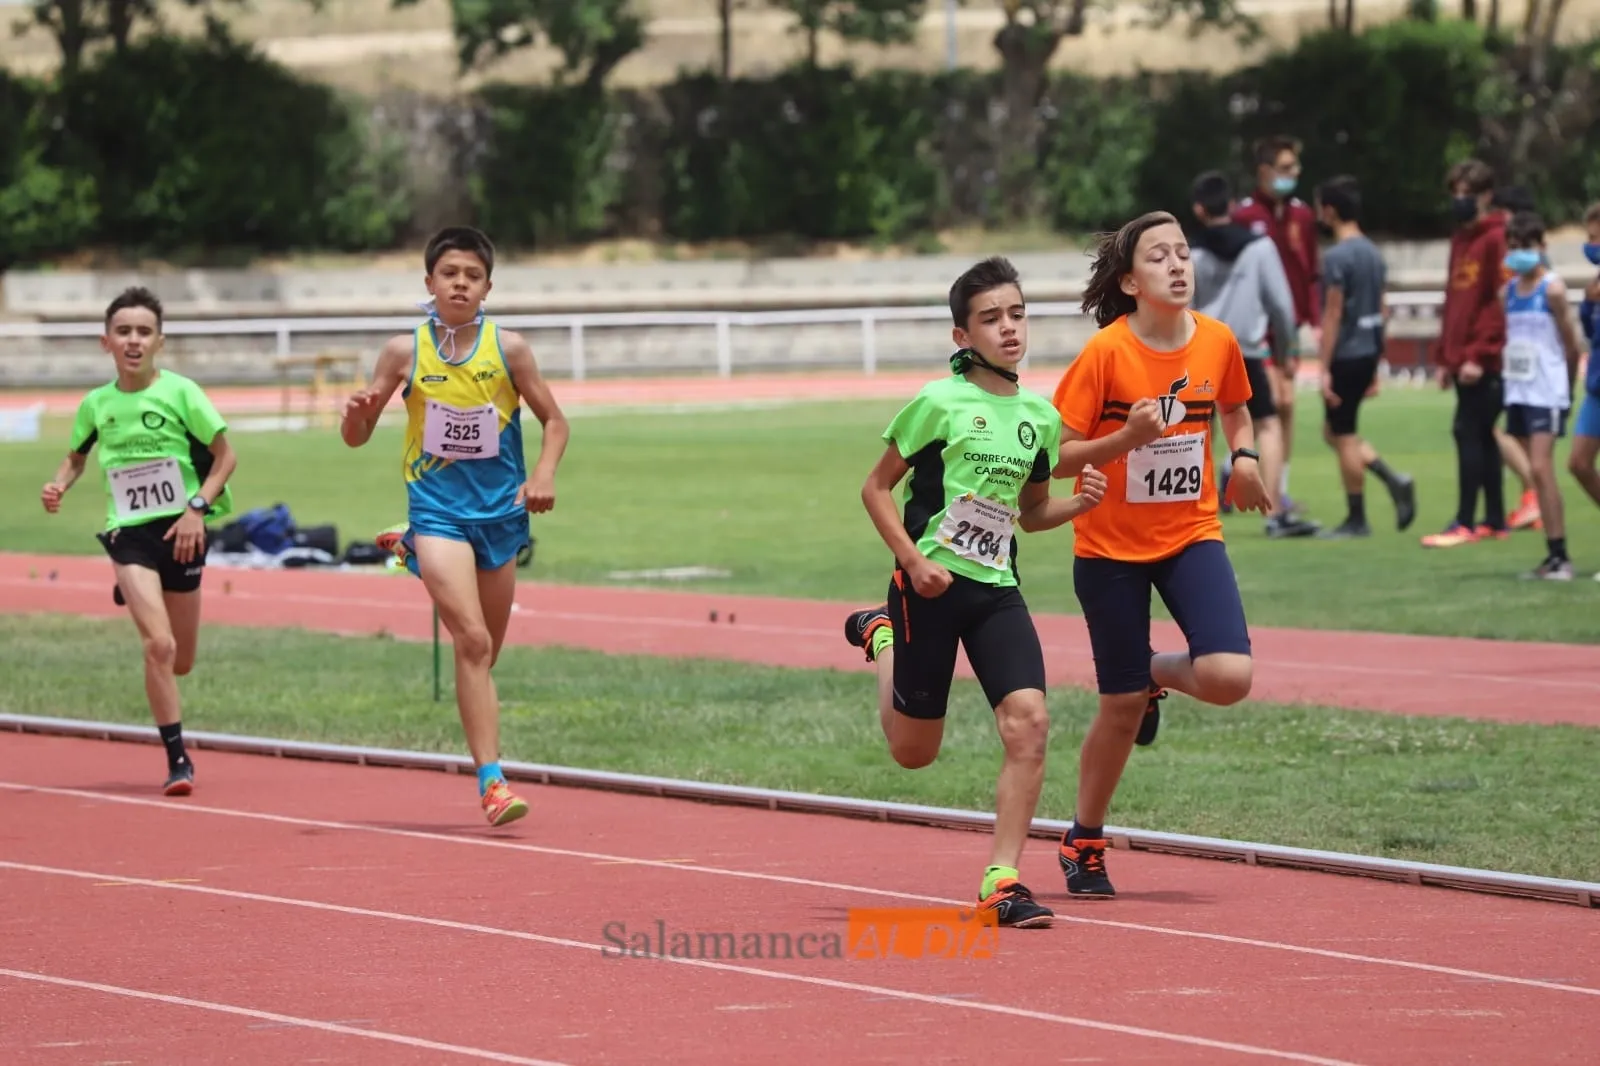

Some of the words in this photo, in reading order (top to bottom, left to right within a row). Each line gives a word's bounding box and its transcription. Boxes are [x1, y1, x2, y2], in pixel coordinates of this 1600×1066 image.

[444, 421, 480, 441] 2525
[126, 480, 175, 511] 2710
[1144, 465, 1201, 497] 1429
